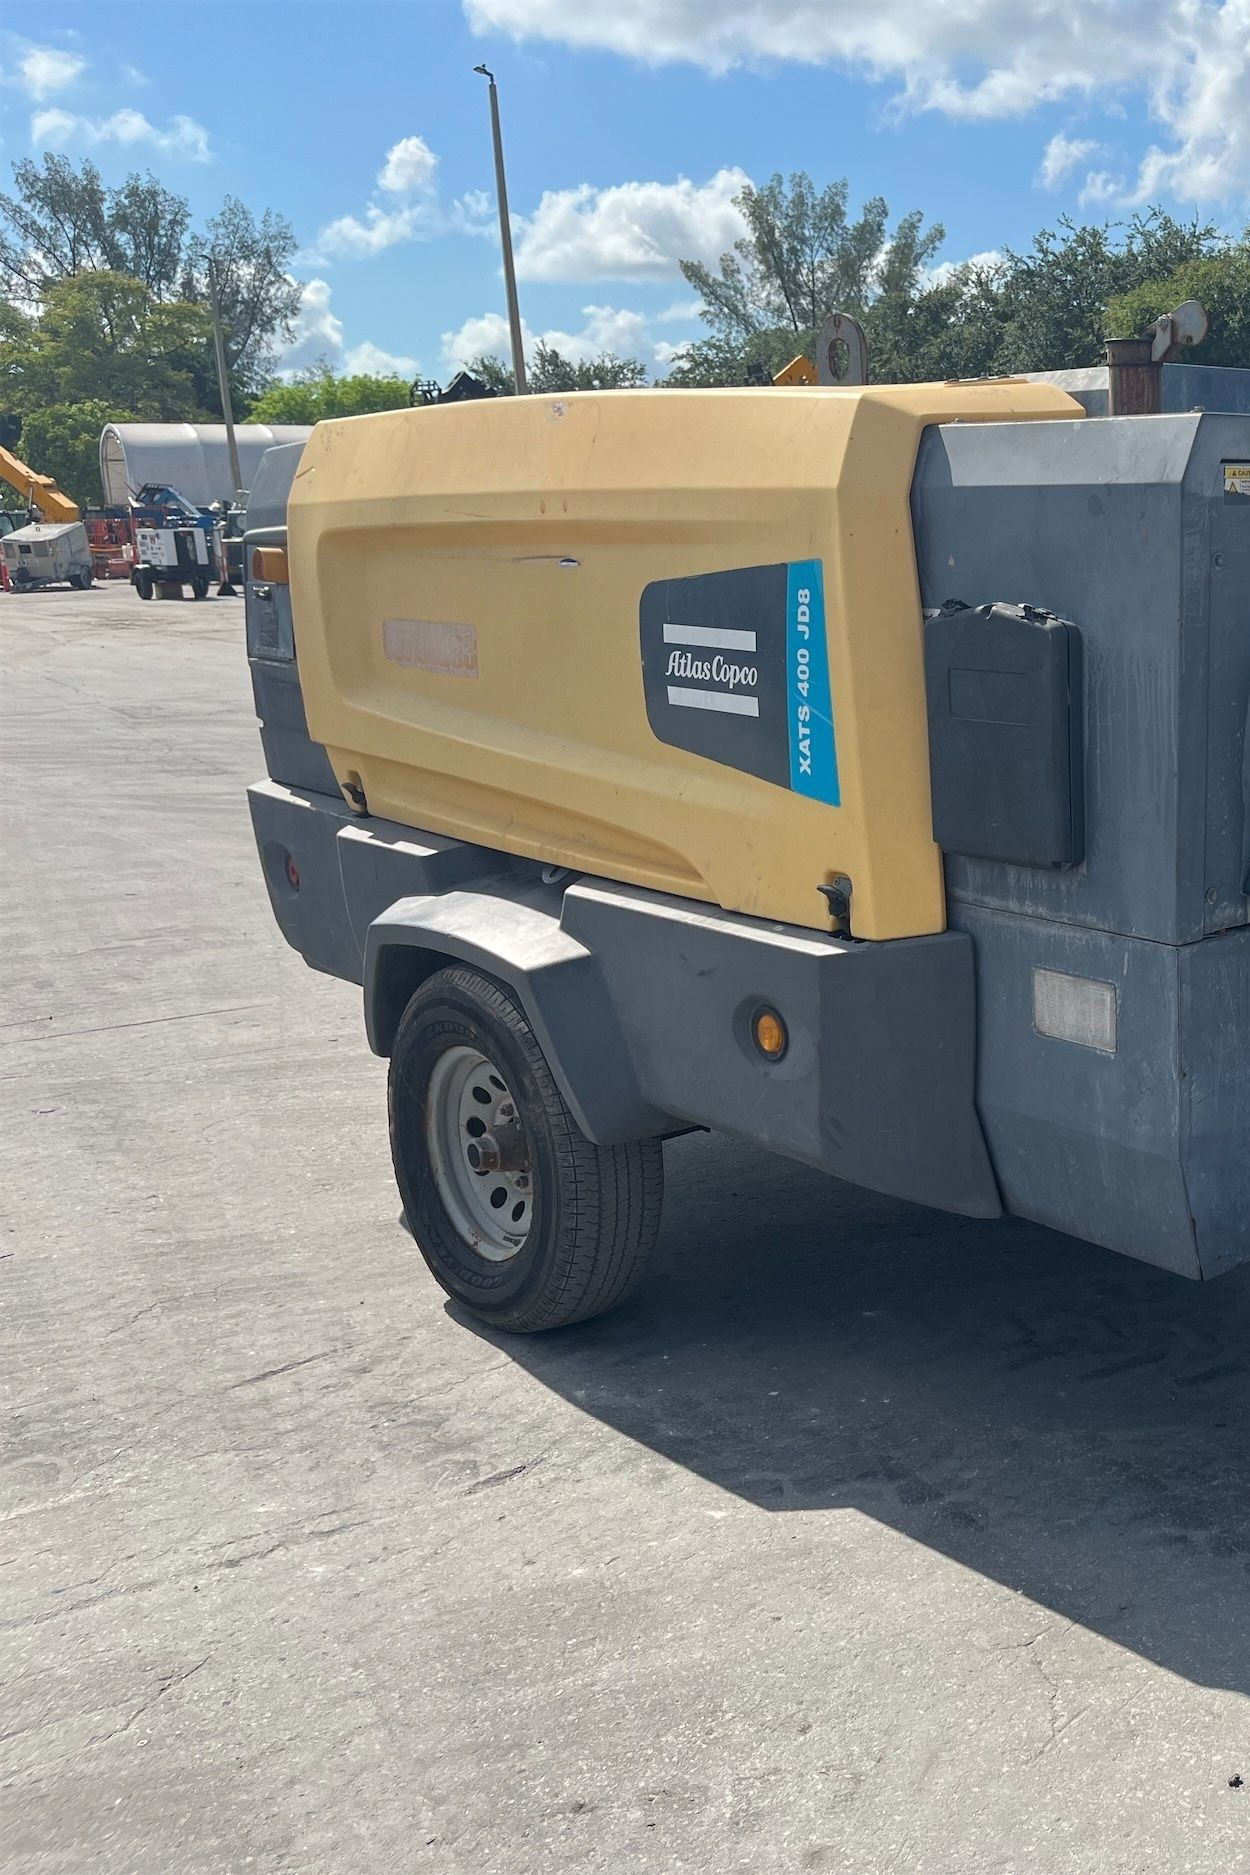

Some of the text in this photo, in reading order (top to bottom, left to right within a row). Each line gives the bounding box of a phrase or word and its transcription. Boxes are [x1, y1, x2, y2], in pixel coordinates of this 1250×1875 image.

[665, 650, 758, 689] Atlas Copco
[796, 588, 812, 776] XATS 400 JD8
